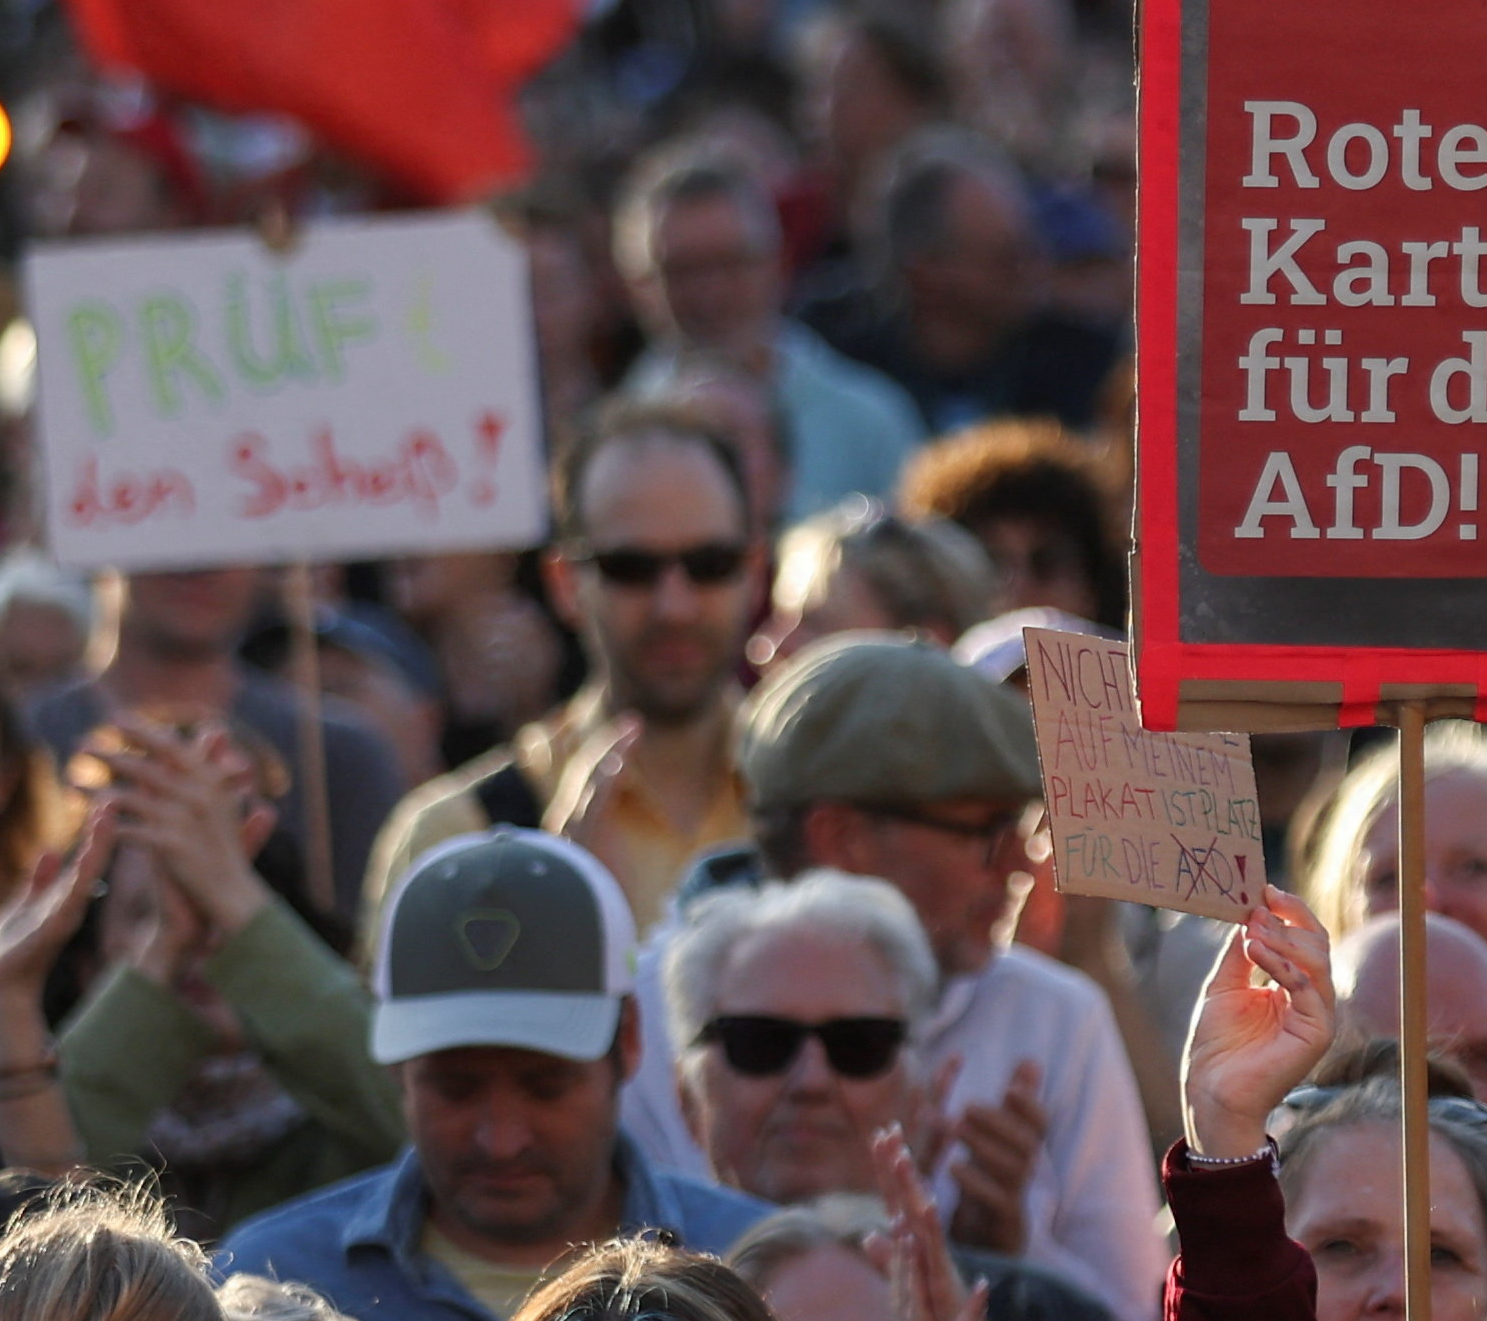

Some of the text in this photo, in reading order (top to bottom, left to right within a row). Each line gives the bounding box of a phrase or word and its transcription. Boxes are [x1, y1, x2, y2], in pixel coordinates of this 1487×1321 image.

[1237, 329, 1409, 424] für
[1234, 446, 1479, 541] AfD!
[1037, 638, 1134, 712] NICHT
[1054, 710, 1235, 795] AUF MEINEM
[1051, 775, 1261, 842] PLAKAT IST PLATZ
[1064, 825, 1121, 884] FÜR
[1121, 836, 1165, 891] DIE
